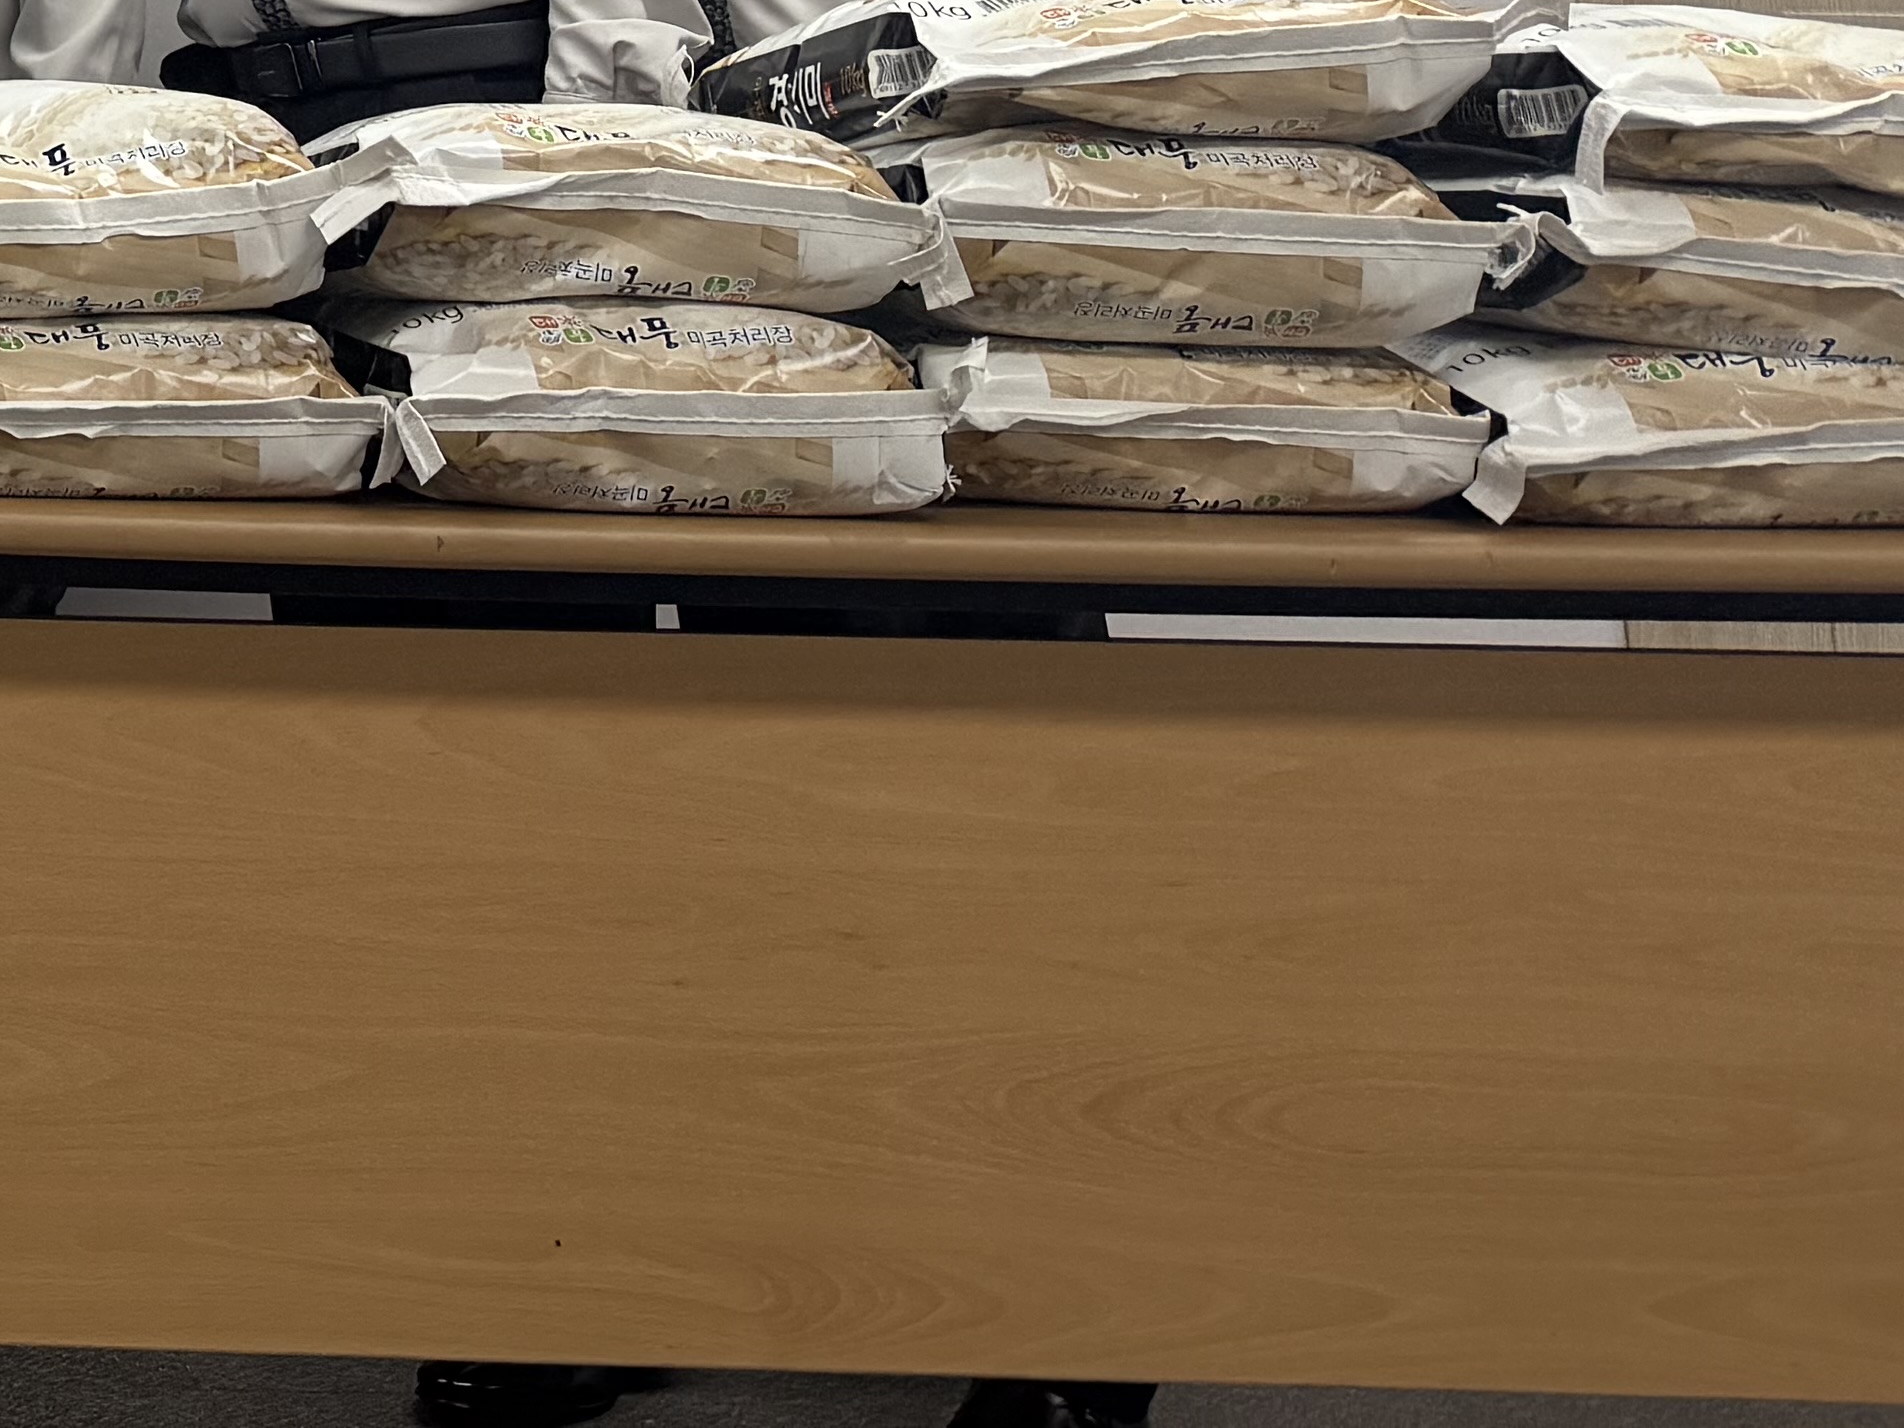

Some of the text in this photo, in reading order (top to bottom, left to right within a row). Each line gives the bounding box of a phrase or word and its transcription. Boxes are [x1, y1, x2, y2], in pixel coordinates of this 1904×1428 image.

[23, 323, 111, 352] 대풍
[592, 316, 794, 350] 대풍 미곡처리장
